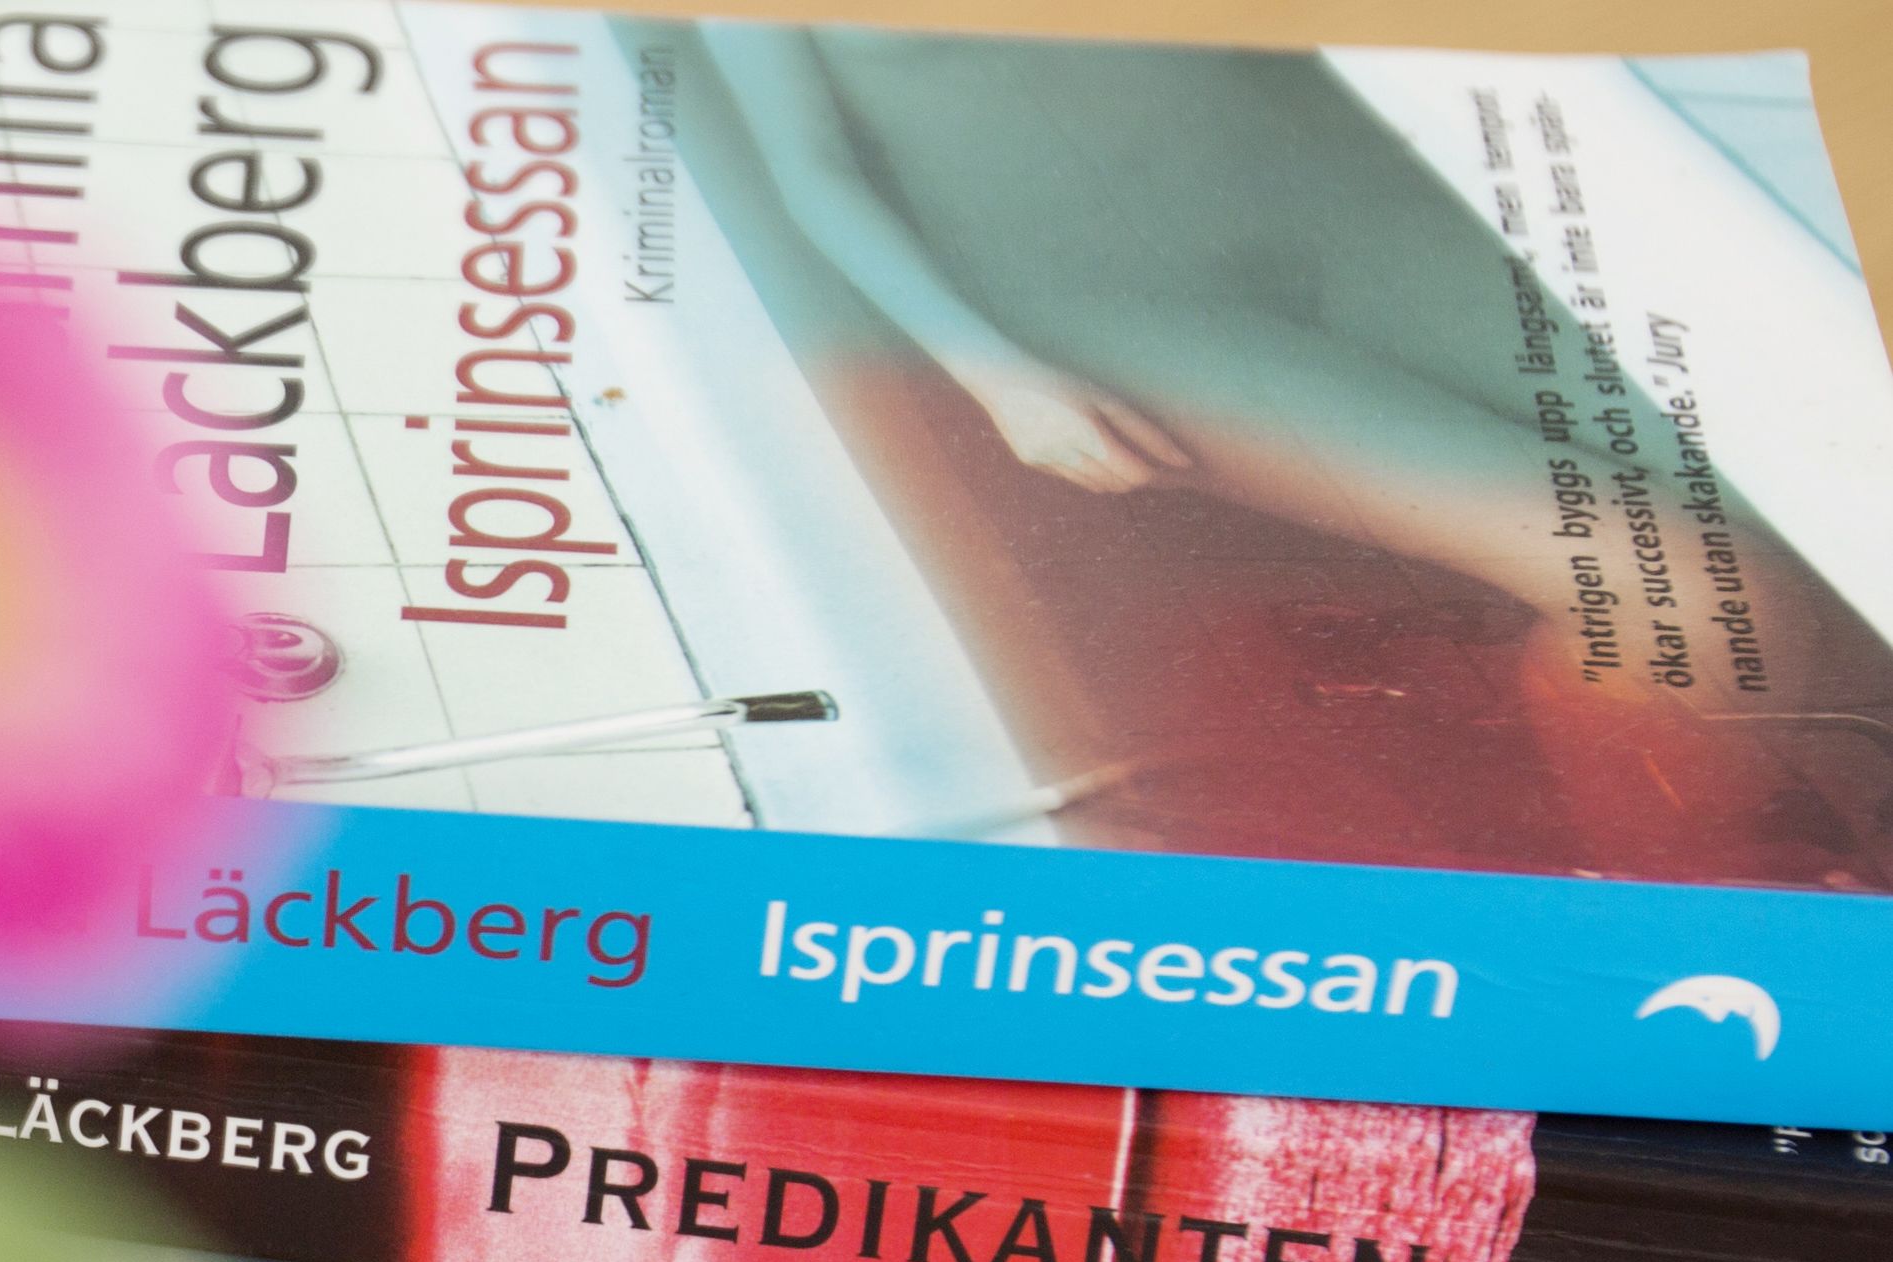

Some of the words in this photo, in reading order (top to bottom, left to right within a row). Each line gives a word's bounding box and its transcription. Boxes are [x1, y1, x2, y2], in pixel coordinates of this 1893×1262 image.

[622, 46, 676, 305] Kriminalroman
[1494, 182, 1529, 236] men
[1550, 164, 1587, 217] bara
[1562, 225, 1599, 273] inte
[108, 25, 383, 574] Läckberg
[1570, 283, 1607, 310] är
[401, 38, 618, 629] Isprinsessan
[1579, 321, 1626, 397] slutet
[1646, 309, 1691, 374] Jury
[1535, 390, 1580, 443] upp
[1592, 406, 1639, 456] och
[1548, 458, 1600, 539] byggs
[1611, 466, 1677, 608] successivt,
[1700, 531, 1745, 593] utan
[1648, 619, 1695, 689] ökar
[1711, 599, 1768, 693] nande
[134, 862, 653, 989] Läckberg
[759, 900, 1460, 1019] Isprinsessan
